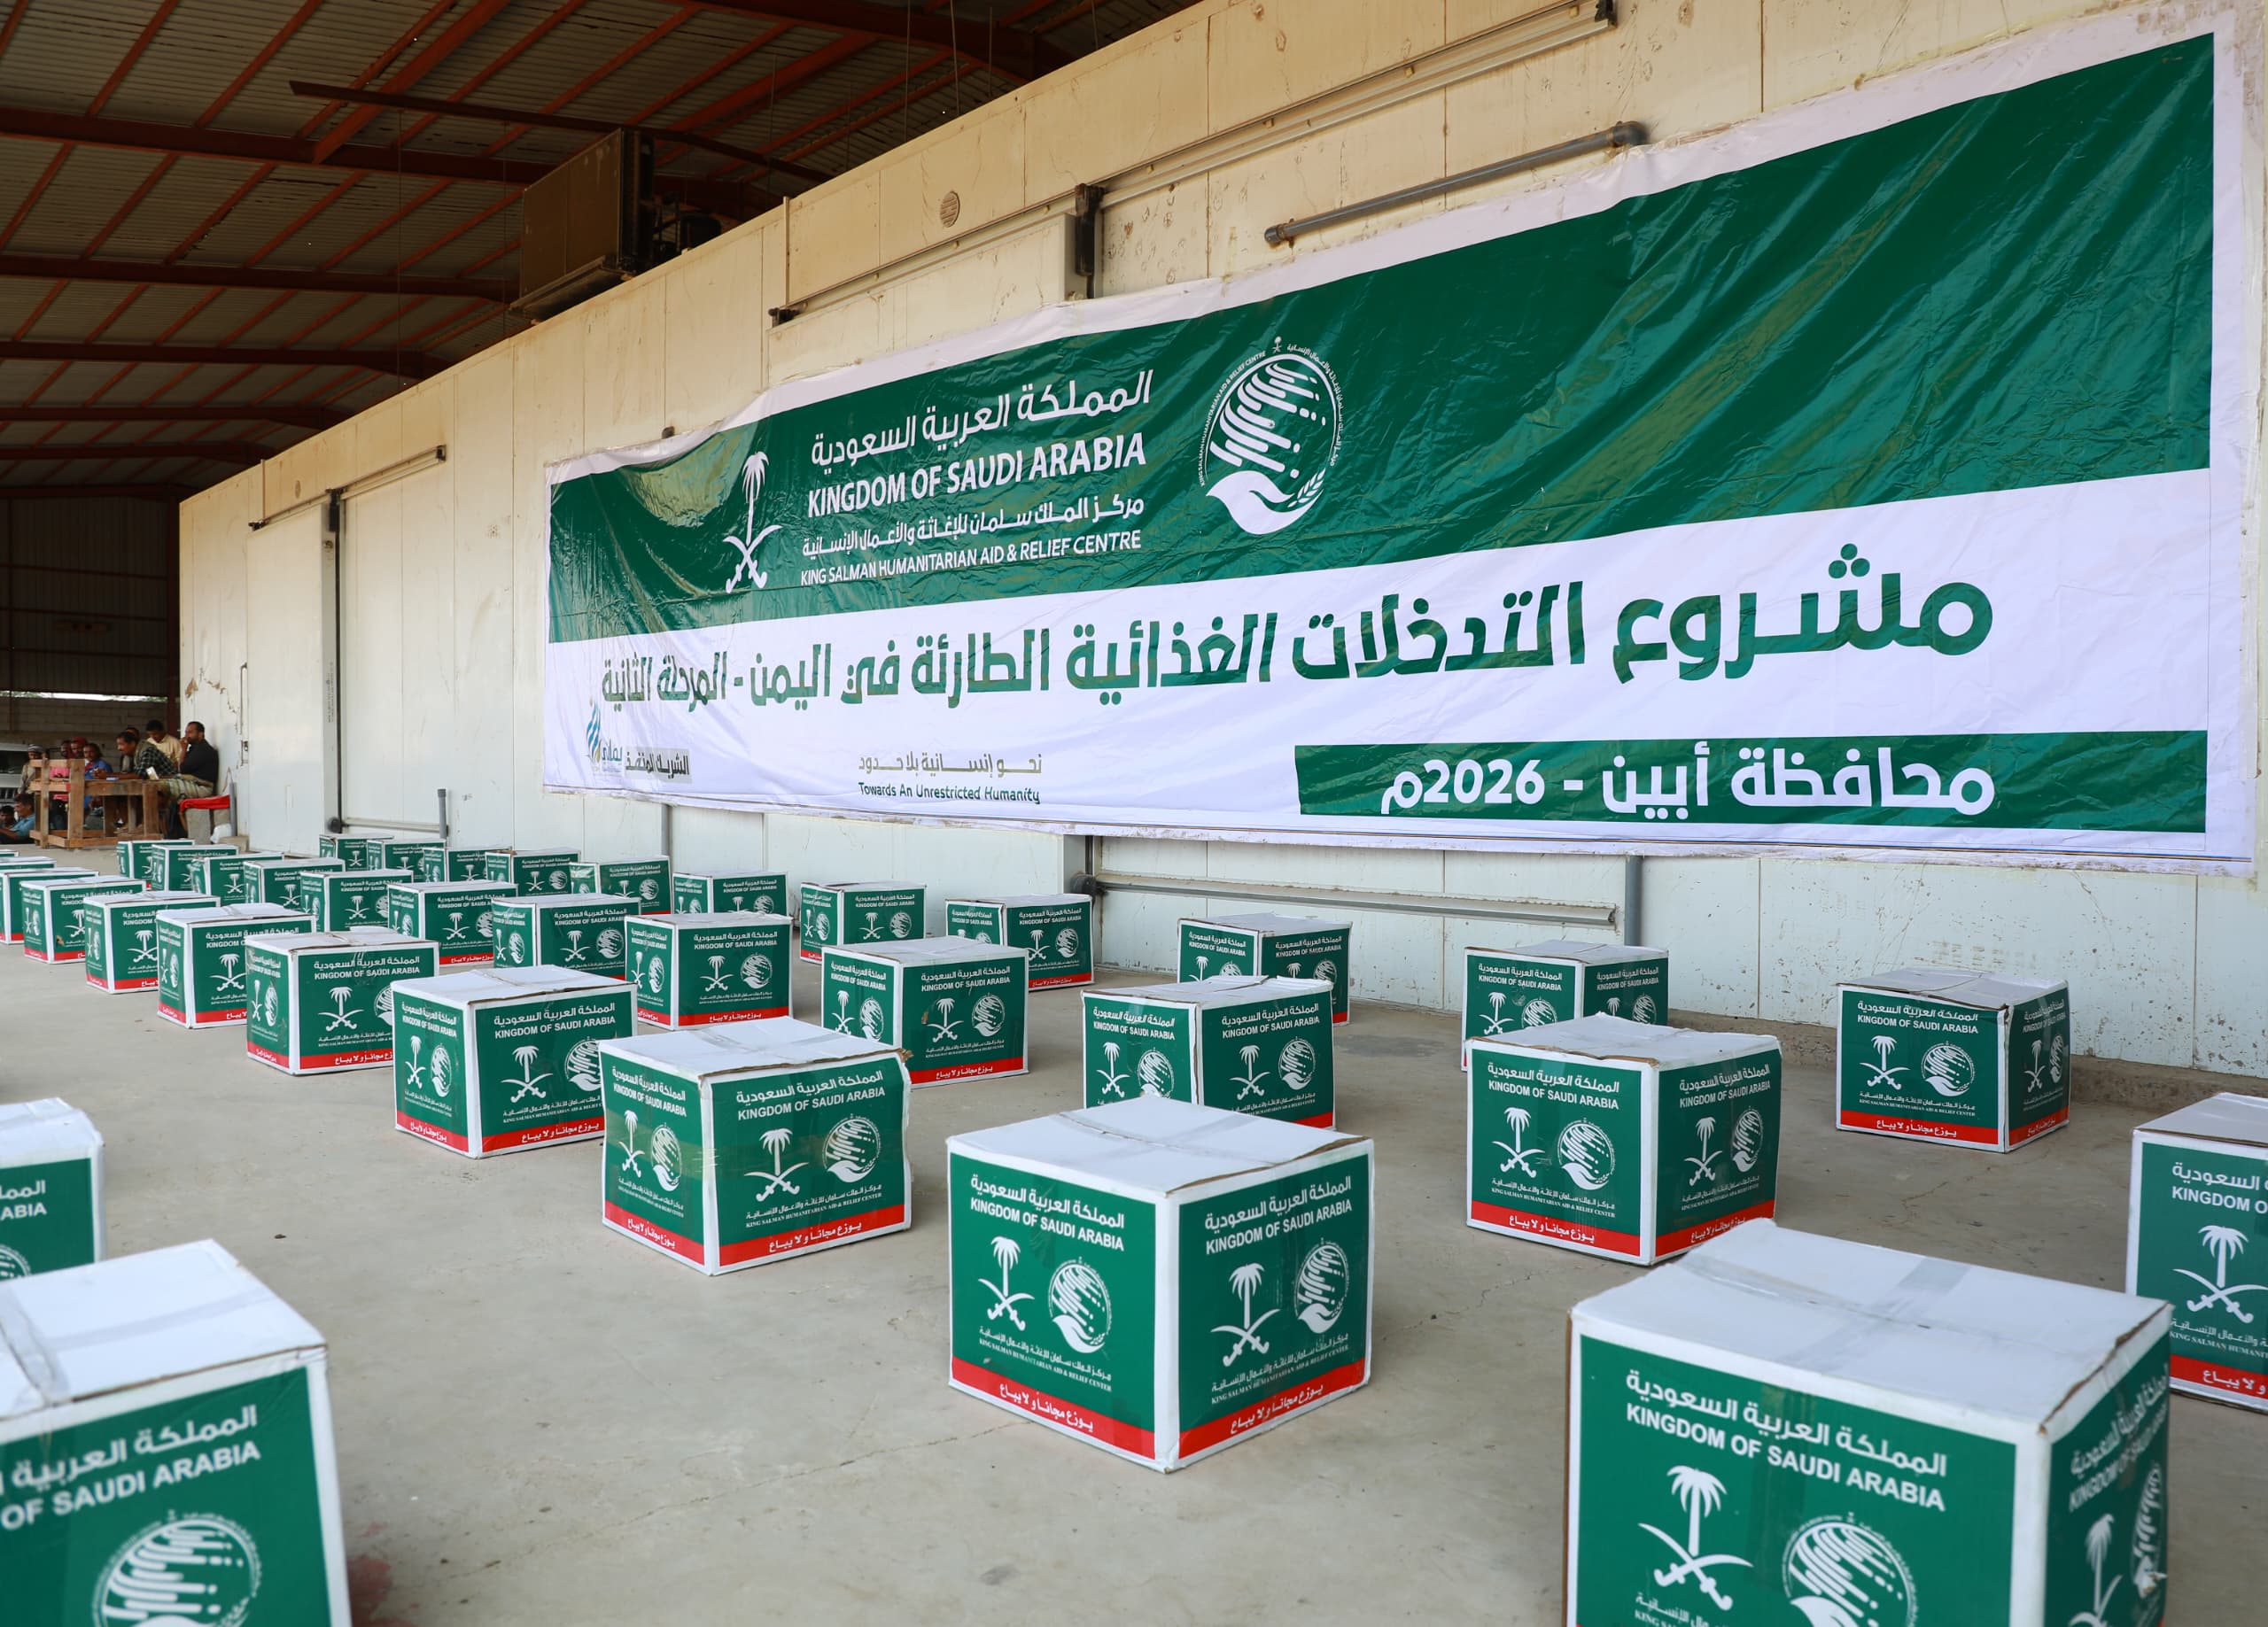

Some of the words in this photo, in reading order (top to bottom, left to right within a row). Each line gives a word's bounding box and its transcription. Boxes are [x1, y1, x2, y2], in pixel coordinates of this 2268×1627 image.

[1017, 369, 1153, 421] المملكة
[923, 393, 1010, 450] العربية
[812, 415, 916, 475] السعودية
[808, 471, 905, 518] KINGDOM
[912, 465, 942, 500] OF
[947, 450, 1021, 494] SAUDI
[1029, 432, 1146, 480] ARABIA
[970, 508, 1031, 535] سلمان
[1035, 498, 1088, 523] الملك
[1092, 493, 1144, 523] مركز
[801, 567, 827, 586] KING
[829, 561, 876, 583] SALMAN
[880, 549, 976, 577] HUMANITARIAN
[980, 546, 1004, 563] AID
[1006, 543, 1017, 562] &
[1020, 537, 1070, 560] RELIEF
[1074, 530, 1141, 555] CENTRE
[1613, 543, 1993, 684] مشروع
[1293, 580, 1584, 682] التدخلات
[840, 639, 900, 704] في
[912, 628, 1050, 709] الطارئة
[1066, 612, 1278, 706] الغذائية
[602, 653, 652, 711] الثانية
[657, 651, 727, 712] المرحلة
[750, 643, 831, 710] اليمن
[858, 755, 904, 773] حدود
[906, 751, 918, 776] بلا
[921, 752, 992, 778] إنسانية
[997, 754, 1042, 778] نحو
[858, 782, 897, 796] Towards
[900, 784, 913, 797] An
[916, 785, 980, 800] Unrestricted
[984, 786, 1040, 804] Humanity
[1381, 759, 1544, 815] 2026م
[1603, 740, 1710, 820] أبين
[1730, 745, 1994, 815] محافظة
[314, 958, 355, 971] السعودية
[357, 958, 385, 968] العربية
[1479, 964, 1510, 973] السعودية
[1511, 967, 1534, 977] العربية
[1534, 970, 1562, 980] المملكة
[1479, 975, 1507, 984] KINGDOM
[1858, 1001, 1901, 1013] السعودية
[1903, 1005, 1936, 1018] العربية
[1938, 1010, 1977, 1021] المملكة
[1858, 1015, 1897, 1026] KINGDOM
[1914, 1020, 1939, 1030] SAUDI
[1942, 1024, 1977, 1034] ARABIA
[838, 1071, 883, 1086] المملكة
[1488, 1062, 1534, 1080] السعودية
[1536, 1070, 1573, 1086] العربية
[1574, 1075, 1619, 1092] المملكة
[736, 1085, 795, 1105] السعودية
[797, 1079, 836, 1096] العربية
[1489, 1080, 1530, 1096] KINGDOM
[1533, 1088, 1545, 1097] OF
[1548, 1090, 1577, 1104] SAUDI
[1580, 1095, 1619, 1109] ARABIA
[738, 1103, 791, 1120] KINGDOM
[795, 1100, 809, 1111] OF
[812, 1094, 843, 1108] SAUDI
[846, 1087, 885, 1103] ARABIA
[971, 1174, 1027, 1203] السعودية
[1309, 1176, 1351, 1199] المملكة
[2172, 1161, 2260, 1190] السعودية
[1, 1203, 47, 1220] ABIA
[1029, 1189, 1070, 1214] العربية
[1269, 1189, 1307, 1216] العربية
[2172, 1186, 2249, 1212] KINGDOM
[971, 1197, 1020, 1222] KINGDOM
[1022, 1212, 1037, 1226] OF
[1041, 1217, 1075, 1237] SAUDI
[1078, 1228, 1123, 1251] ARABIA
[1073, 1200, 1124, 1228] المملكة
[1205, 1201, 1266, 1234] السعودية
[1207, 1227, 1262, 1254] KINGDOM
[1266, 1221, 1281, 1237] OF
[1283, 1212, 1314, 1232] SAUDI
[1317, 1199, 1352, 1222] ARABIA
[1000, 1383, 1021, 1404] يباع
[1627, 1369, 1737, 1421] السعودية
[135, 1404, 258, 1453] المملكة
[1067, 1411, 1093, 1431] يوزع
[1744, 1401, 1829, 1445] العربية
[12, 1437, 127, 1491] العربية
[1627, 1403, 1725, 1449] KINGDOM
[1731, 1435, 1761, 1458] OF
[1767, 1445, 1840, 1483] SAUDI
[1846, 1468, 1945, 1511] ARABIA
[1836, 1426, 1946, 1476] المملكة
[1, 1499, 43, 1530] OF
[52, 1471, 145, 1515] SAUDI
[153, 1440, 261, 1488] ARABIA
